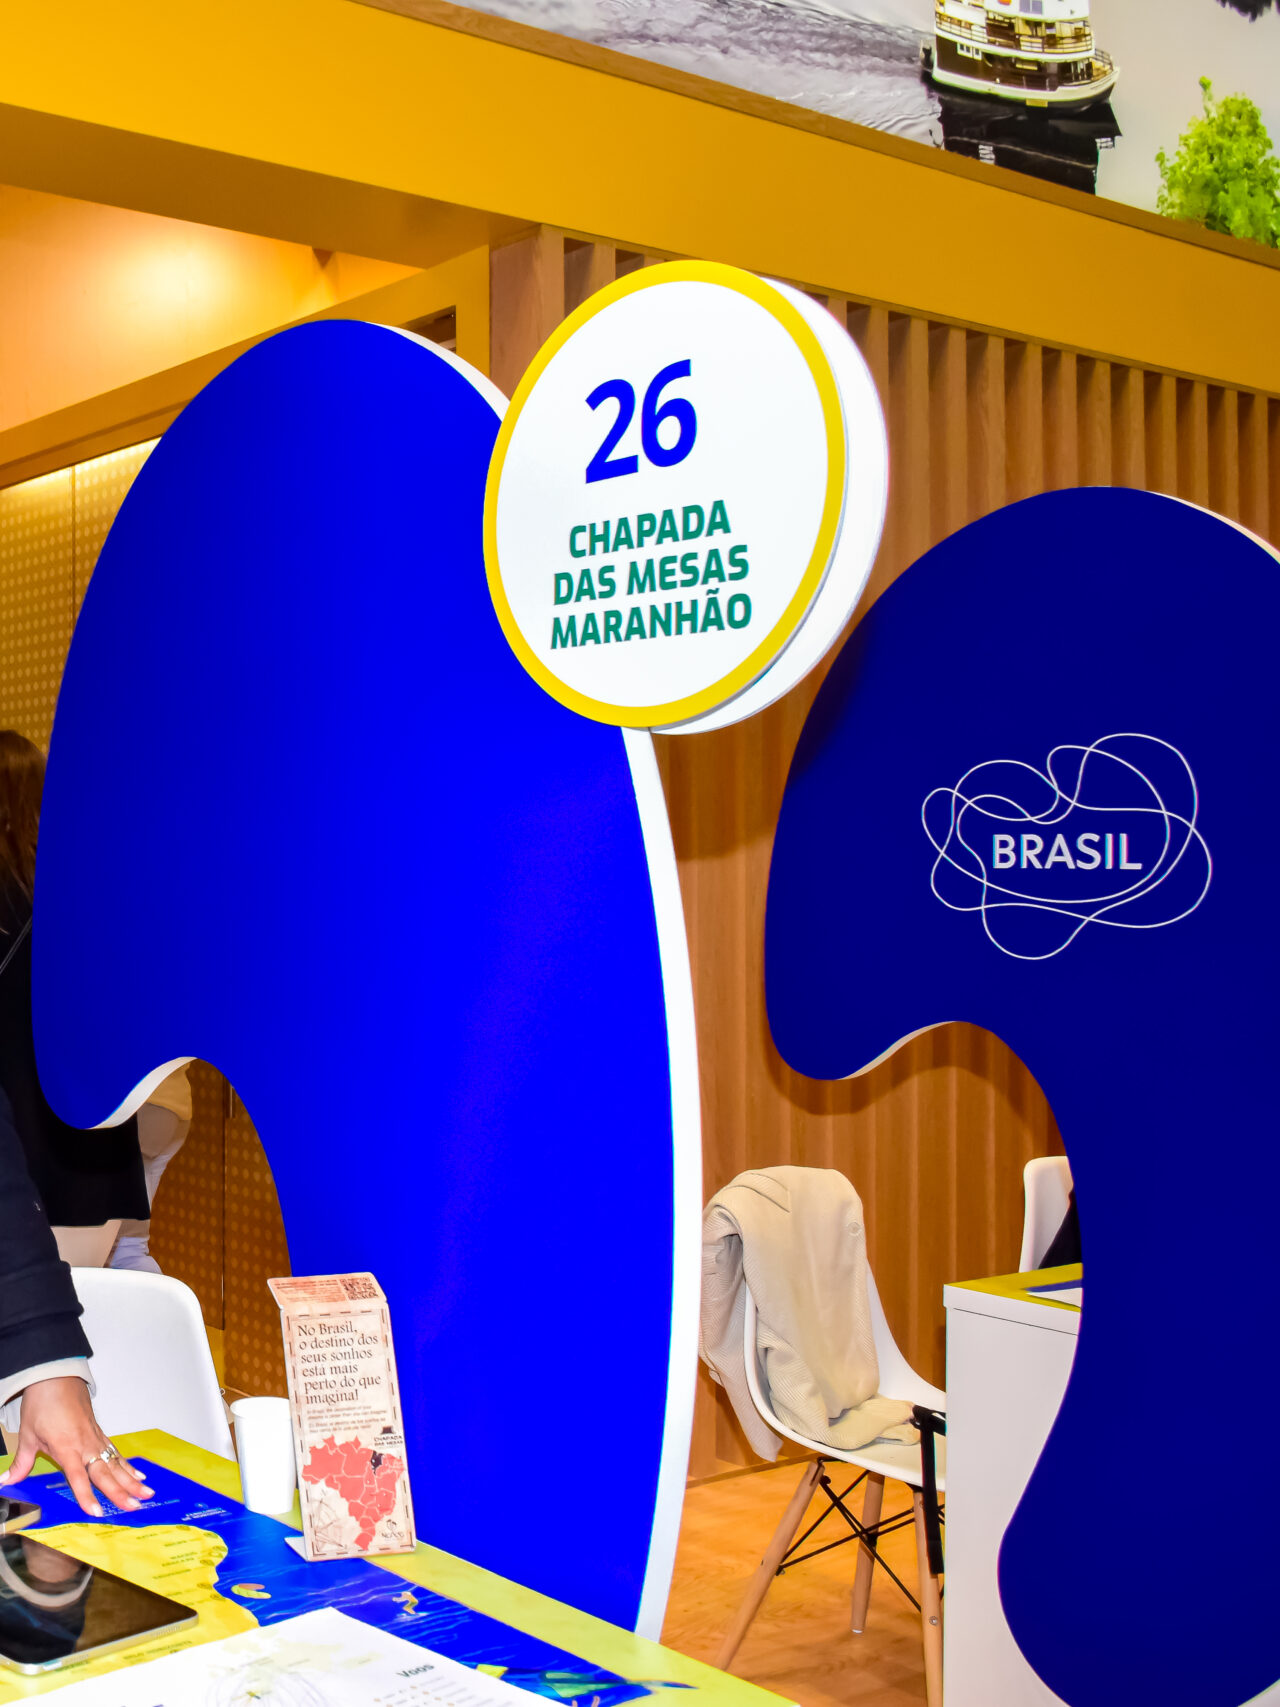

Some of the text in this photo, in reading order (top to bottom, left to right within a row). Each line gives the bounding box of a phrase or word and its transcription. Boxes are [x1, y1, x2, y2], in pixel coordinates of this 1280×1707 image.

[585, 358, 697, 484] 26
[569, 499, 731, 560] CHAPADA
[553, 544, 749, 606] DAS MESAS
[550, 588, 752, 650] MARANHÃO
[992, 831, 1142, 871] BRASIL
[297, 1321, 358, 1337] No Brasil,
[299, 1333, 379, 1350] o destino dos
[301, 1348, 373, 1364] seus sonhos
[302, 1362, 358, 1377] está mais
[304, 1375, 381, 1395] perto do que
[305, 1389, 359, 1406] imagina!
[396, 1662, 435, 1680] Voos
